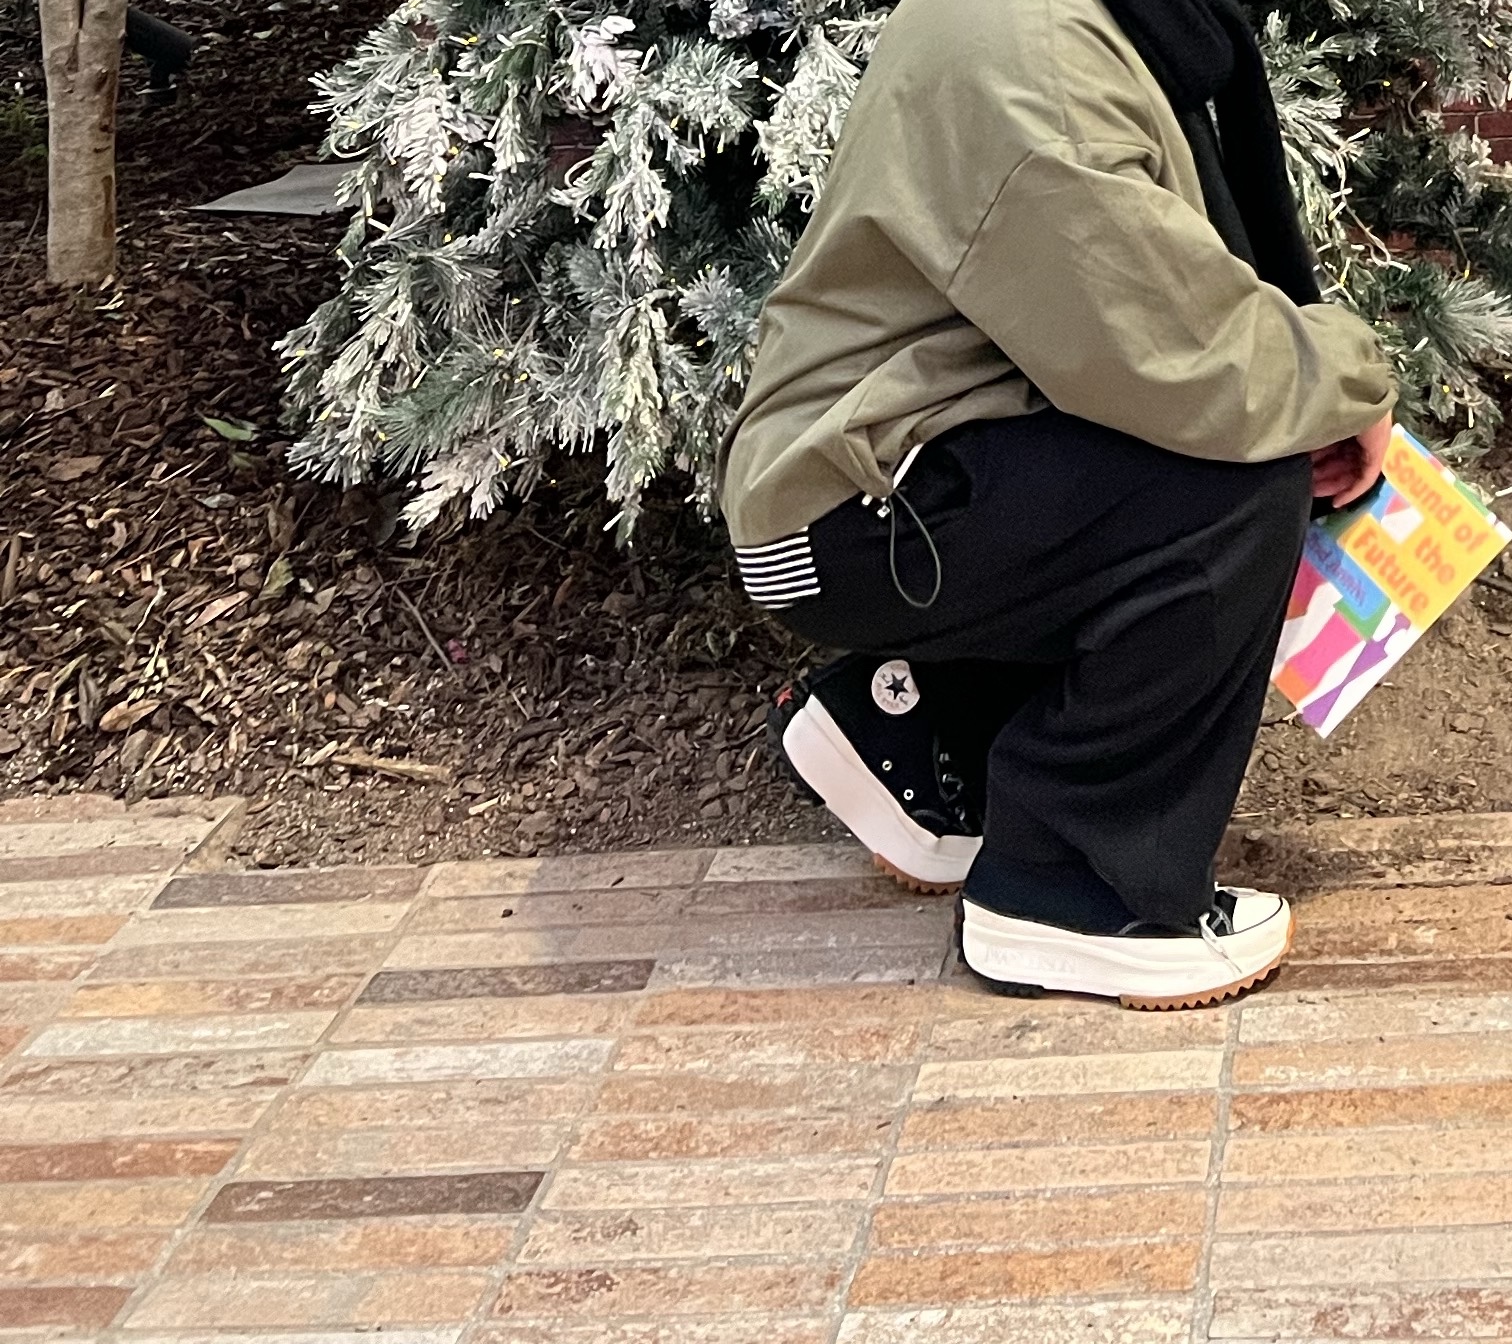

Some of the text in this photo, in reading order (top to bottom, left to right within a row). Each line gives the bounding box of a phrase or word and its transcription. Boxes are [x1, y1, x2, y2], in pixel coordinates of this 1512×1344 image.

[1386, 448, 1490, 553] Sound of
[1353, 528, 1429, 614] Future
[1414, 536, 1456, 585] the
